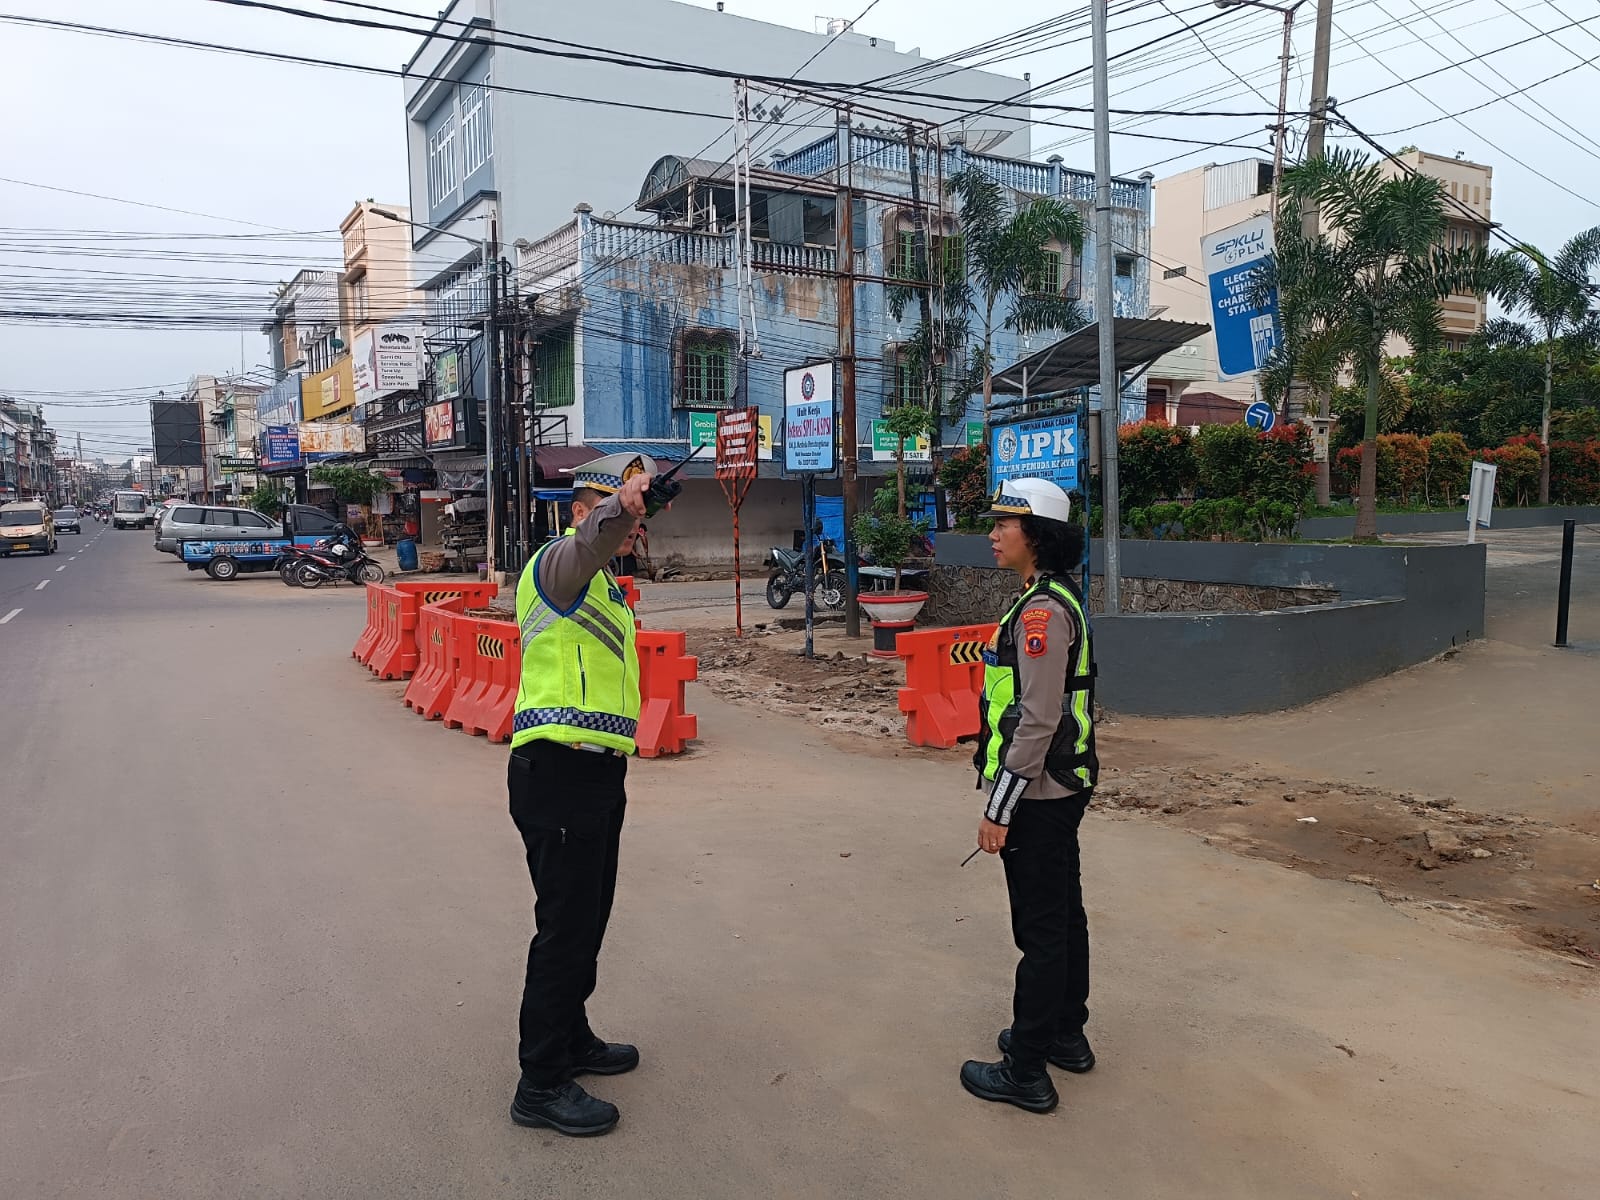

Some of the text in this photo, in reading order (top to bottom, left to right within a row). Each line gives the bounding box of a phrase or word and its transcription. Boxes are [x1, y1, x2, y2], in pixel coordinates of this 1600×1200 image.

[1211, 228, 1264, 256] SPKLU
[1238, 241, 1265, 257] PLN
[1223, 266, 1265, 286] ELECT
[797, 406, 821, 417] Unit Kerja
[1019, 428, 1075, 460] IPK
[1022, 461, 1050, 471] PEMUDA
